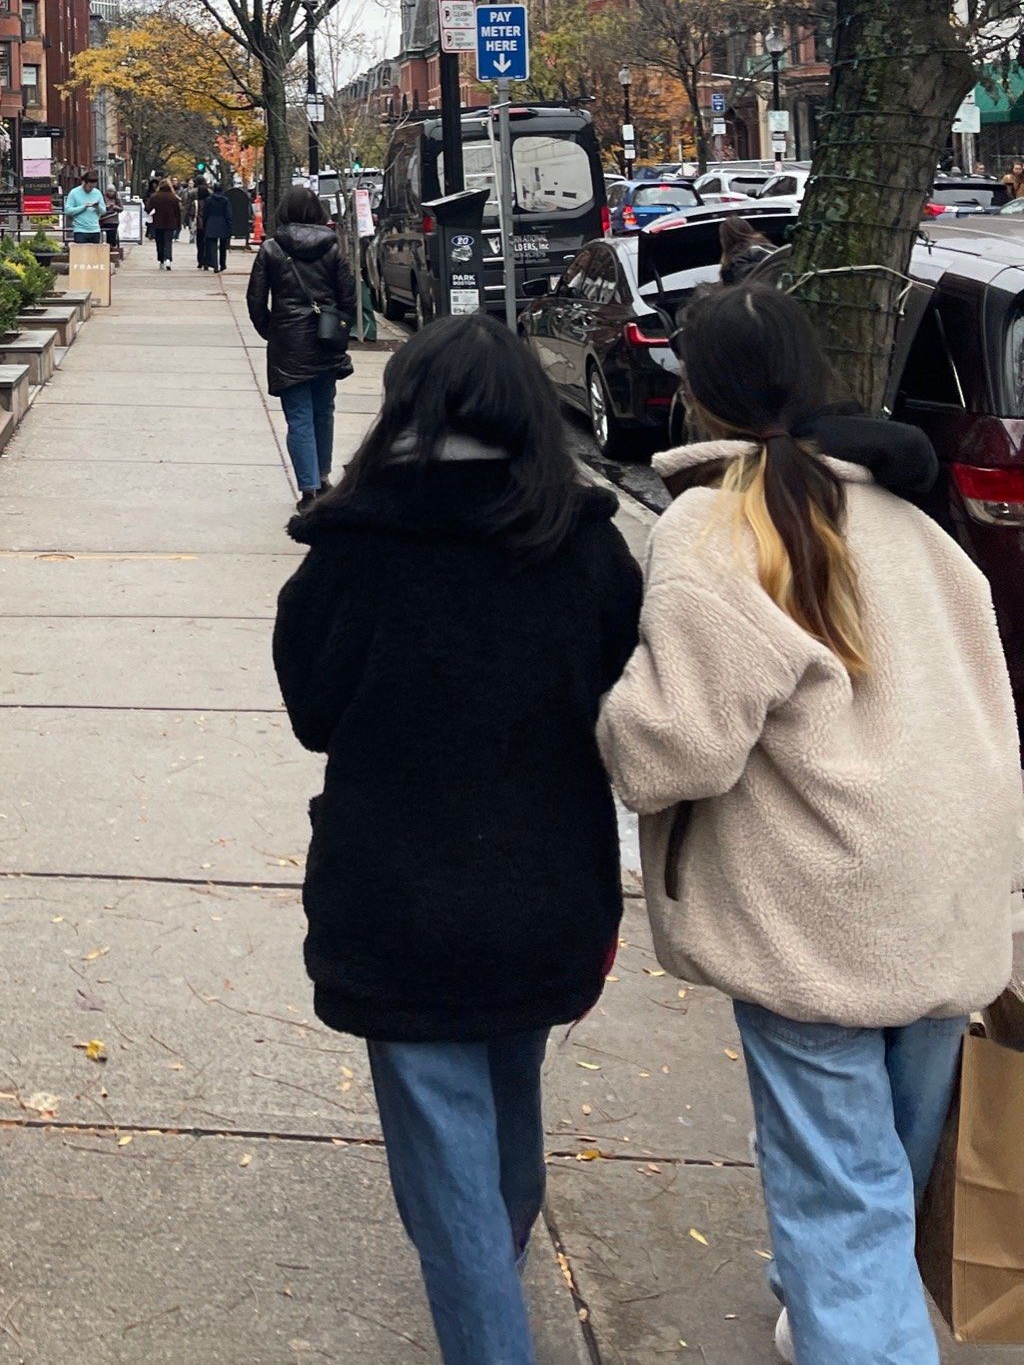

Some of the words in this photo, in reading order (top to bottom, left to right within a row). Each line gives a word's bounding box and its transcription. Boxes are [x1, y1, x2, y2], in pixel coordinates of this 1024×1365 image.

[489, 11, 512, 23] PAY
[481, 25, 521, 37] METER
[486, 40, 518, 52] HERE
[514, 243, 538, 252] LDERS,
